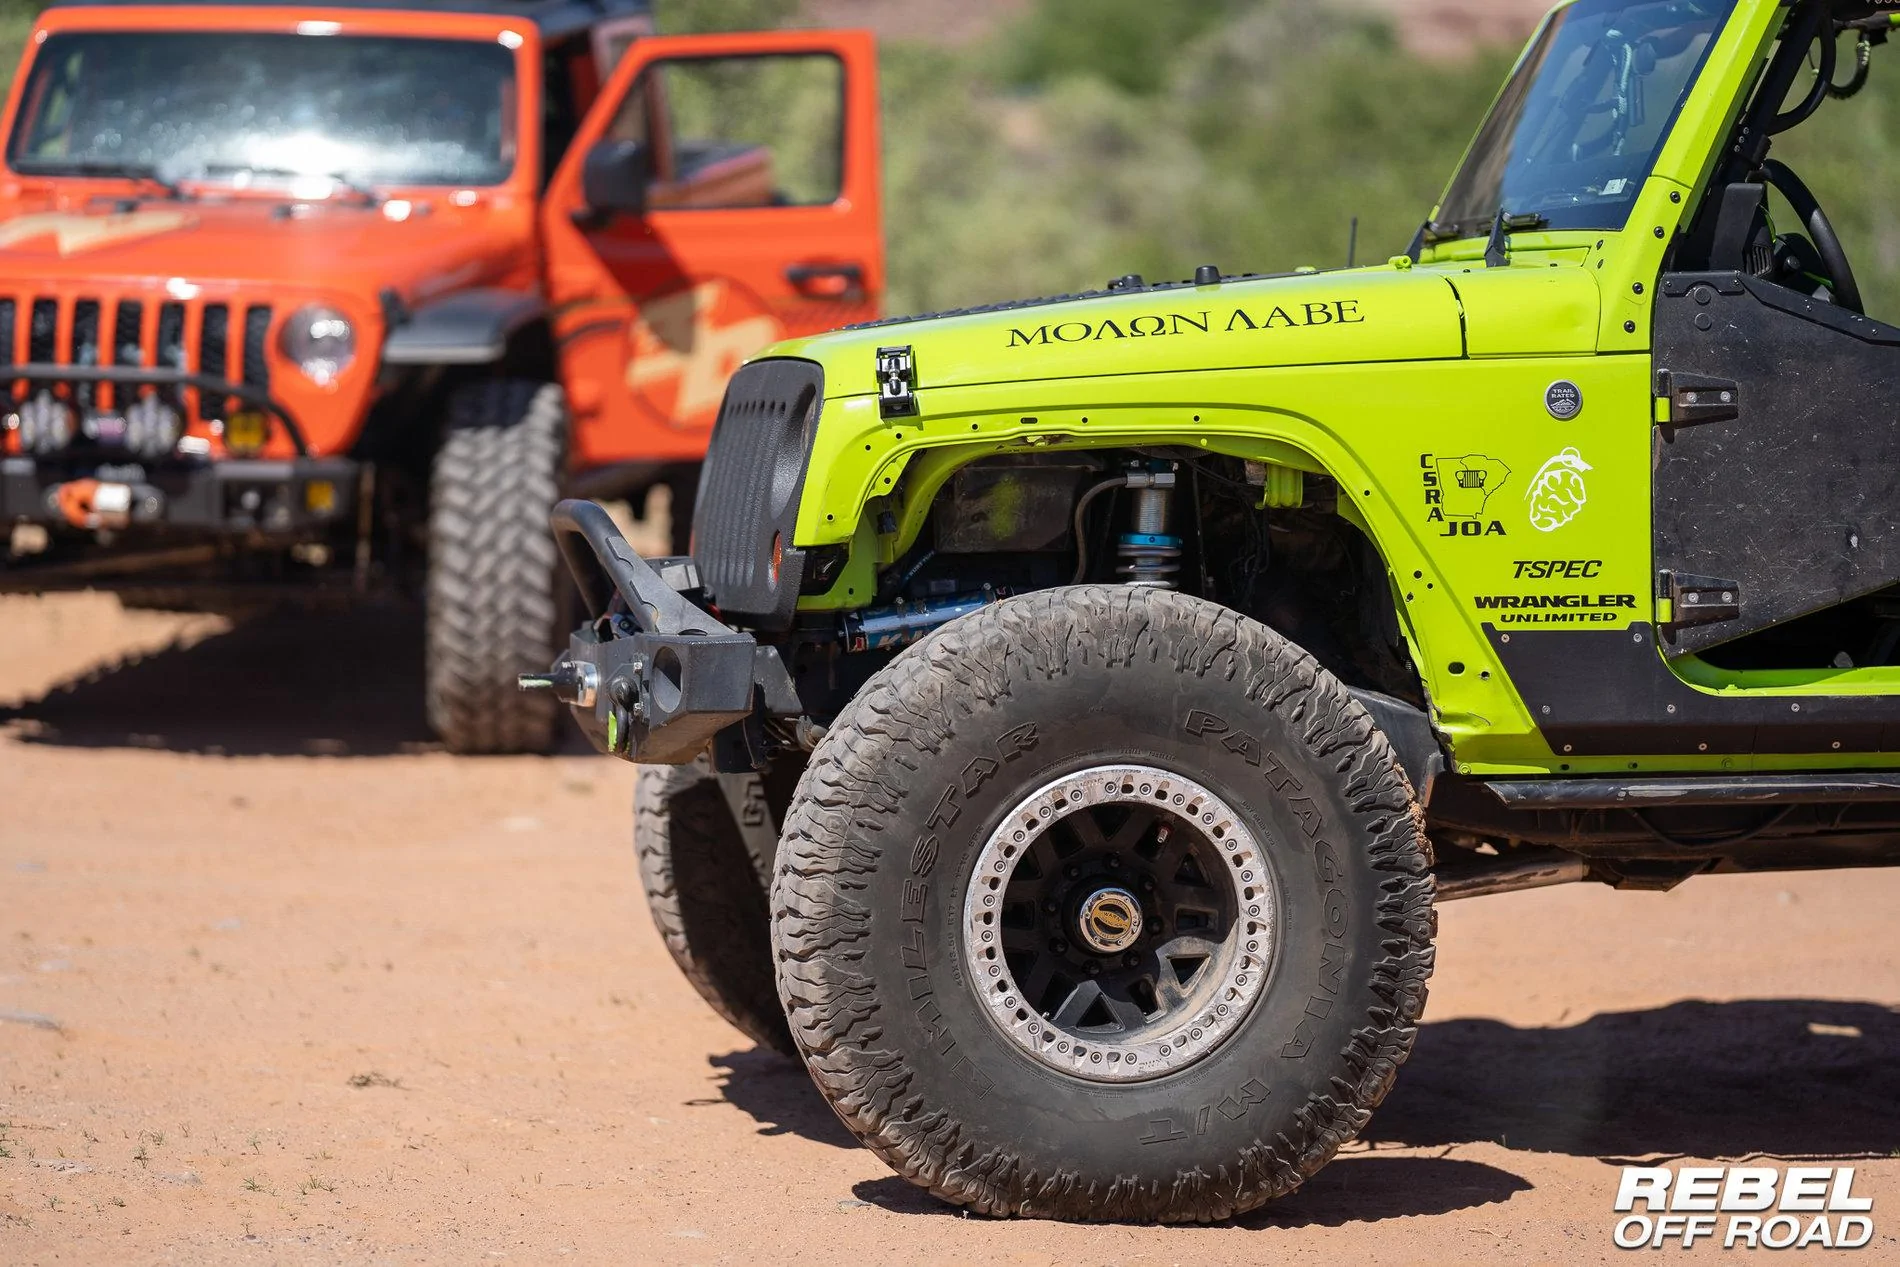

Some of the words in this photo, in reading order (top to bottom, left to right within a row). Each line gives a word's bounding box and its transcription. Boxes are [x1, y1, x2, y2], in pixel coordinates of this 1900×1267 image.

[1439, 520, 1507, 537] JOA
[1474, 594, 1637, 609] WRANGLER
[1500, 612, 1618, 623] UNLIMITED
[900, 721, 1040, 1056] MILESTAR
[1183, 708, 1349, 1061] PATAGONIA
